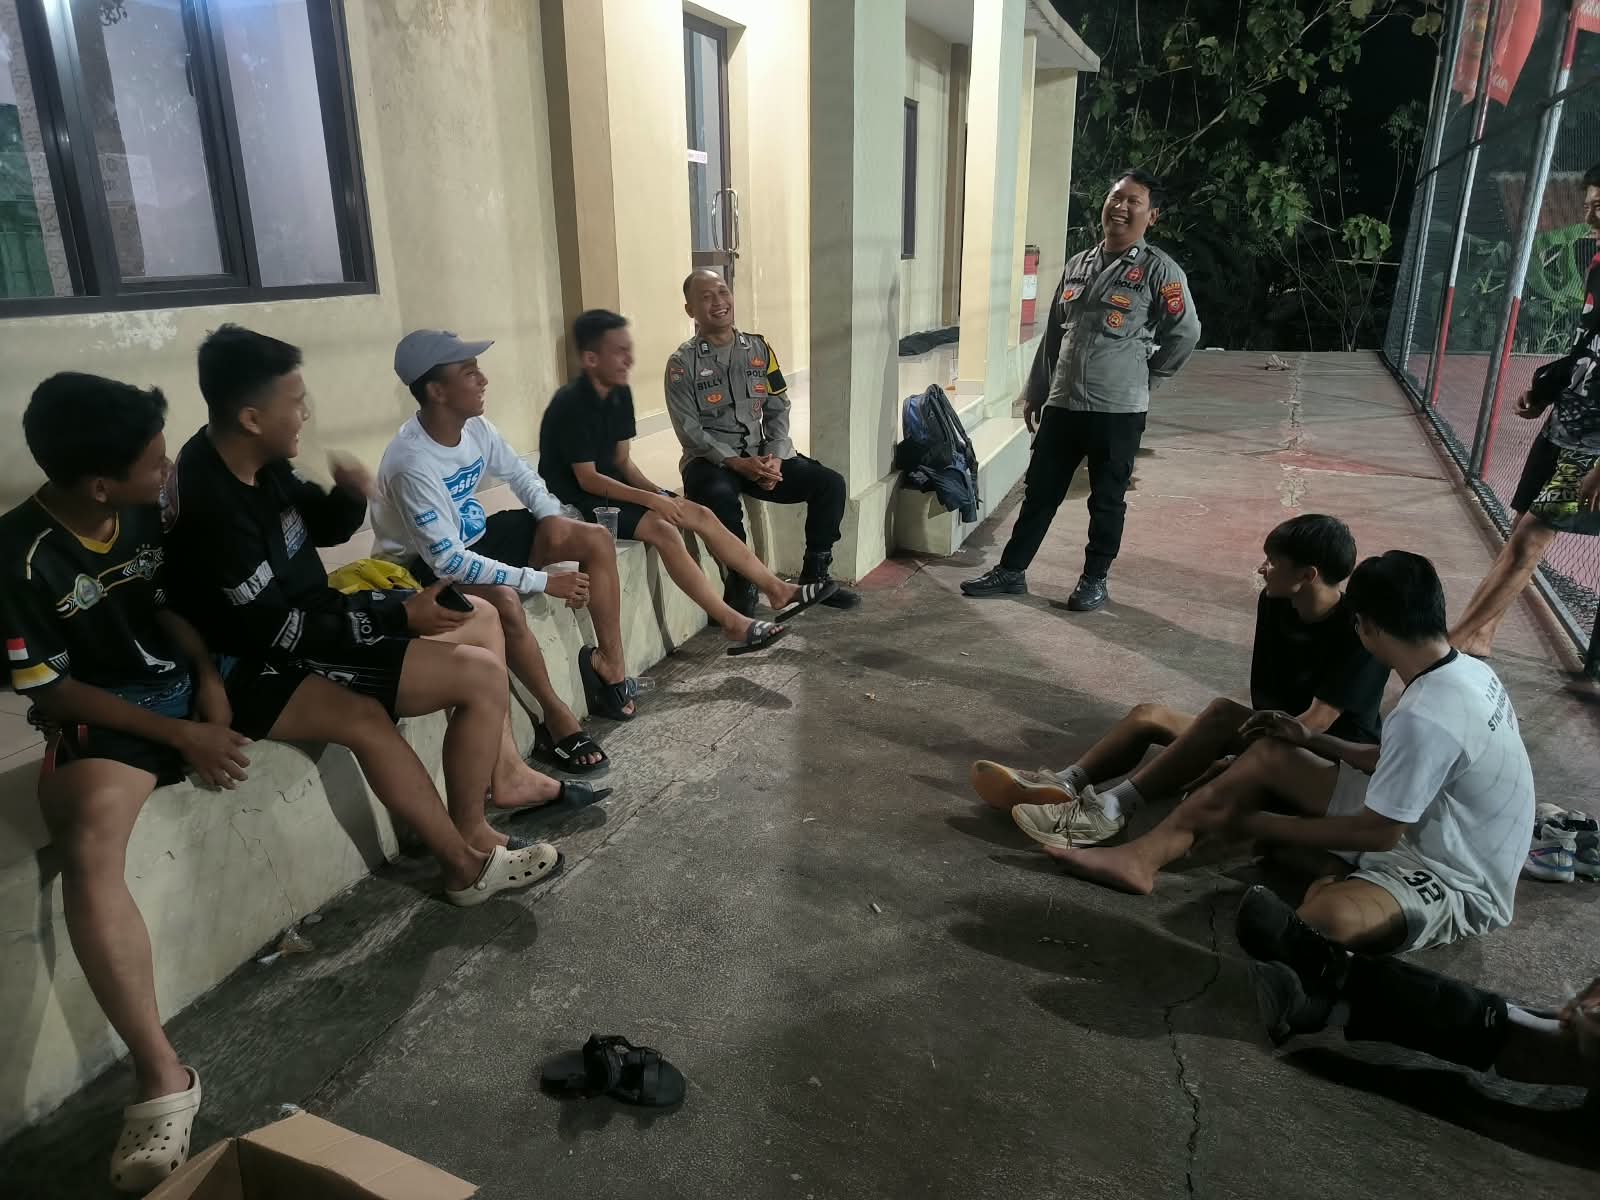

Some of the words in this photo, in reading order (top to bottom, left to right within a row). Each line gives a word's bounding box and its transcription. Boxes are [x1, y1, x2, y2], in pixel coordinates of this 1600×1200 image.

[1114, 279, 1144, 292] POLRI
[450, 473, 479, 496] asis
[1402, 870, 1441, 906] 32
